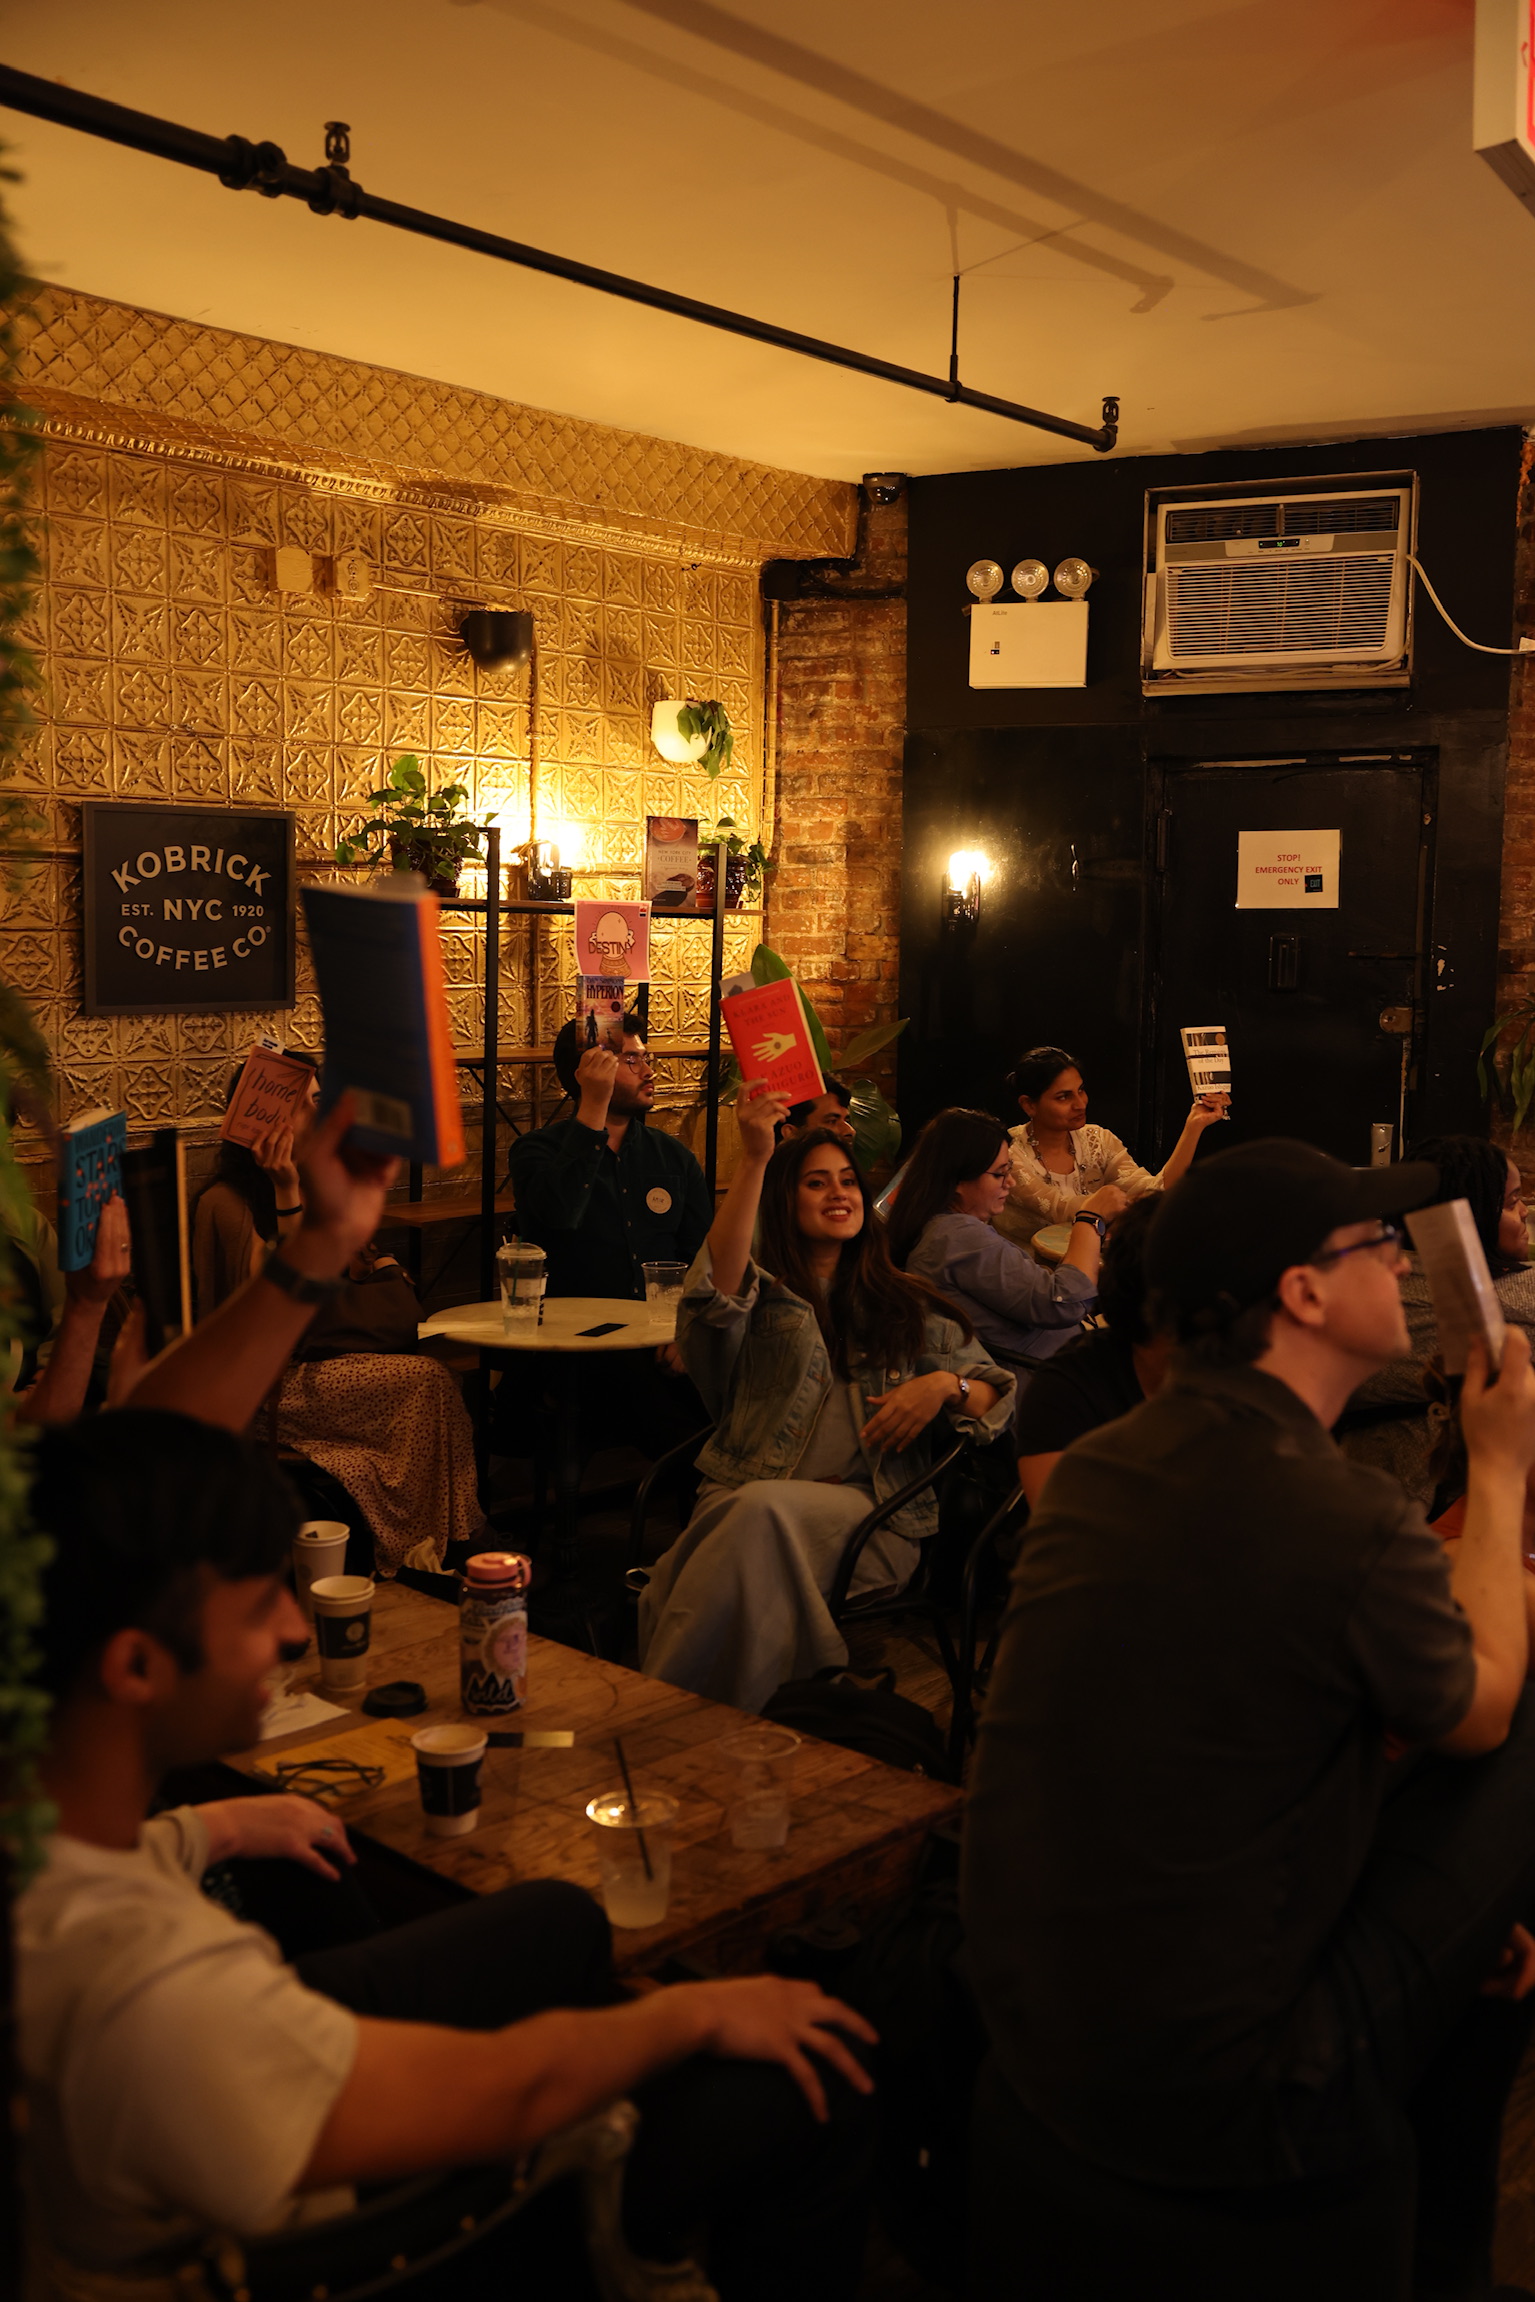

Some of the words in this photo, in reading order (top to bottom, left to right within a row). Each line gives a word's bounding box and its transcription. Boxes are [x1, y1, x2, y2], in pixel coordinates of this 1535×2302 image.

[660, 855, 689, 863] COFFEE
[1277, 854, 1301, 862] STOP!
[110, 845, 272, 897] KOBRICK
[121, 904, 154, 917] EST.
[163, 899, 222, 921] NYC
[232, 904, 264, 917] 1920
[118, 925, 228, 971] COFFEE
[588, 941, 634, 955] DESTINY
[587, 985, 624, 999] HYPERION
[251, 1068, 298, 1103] home
